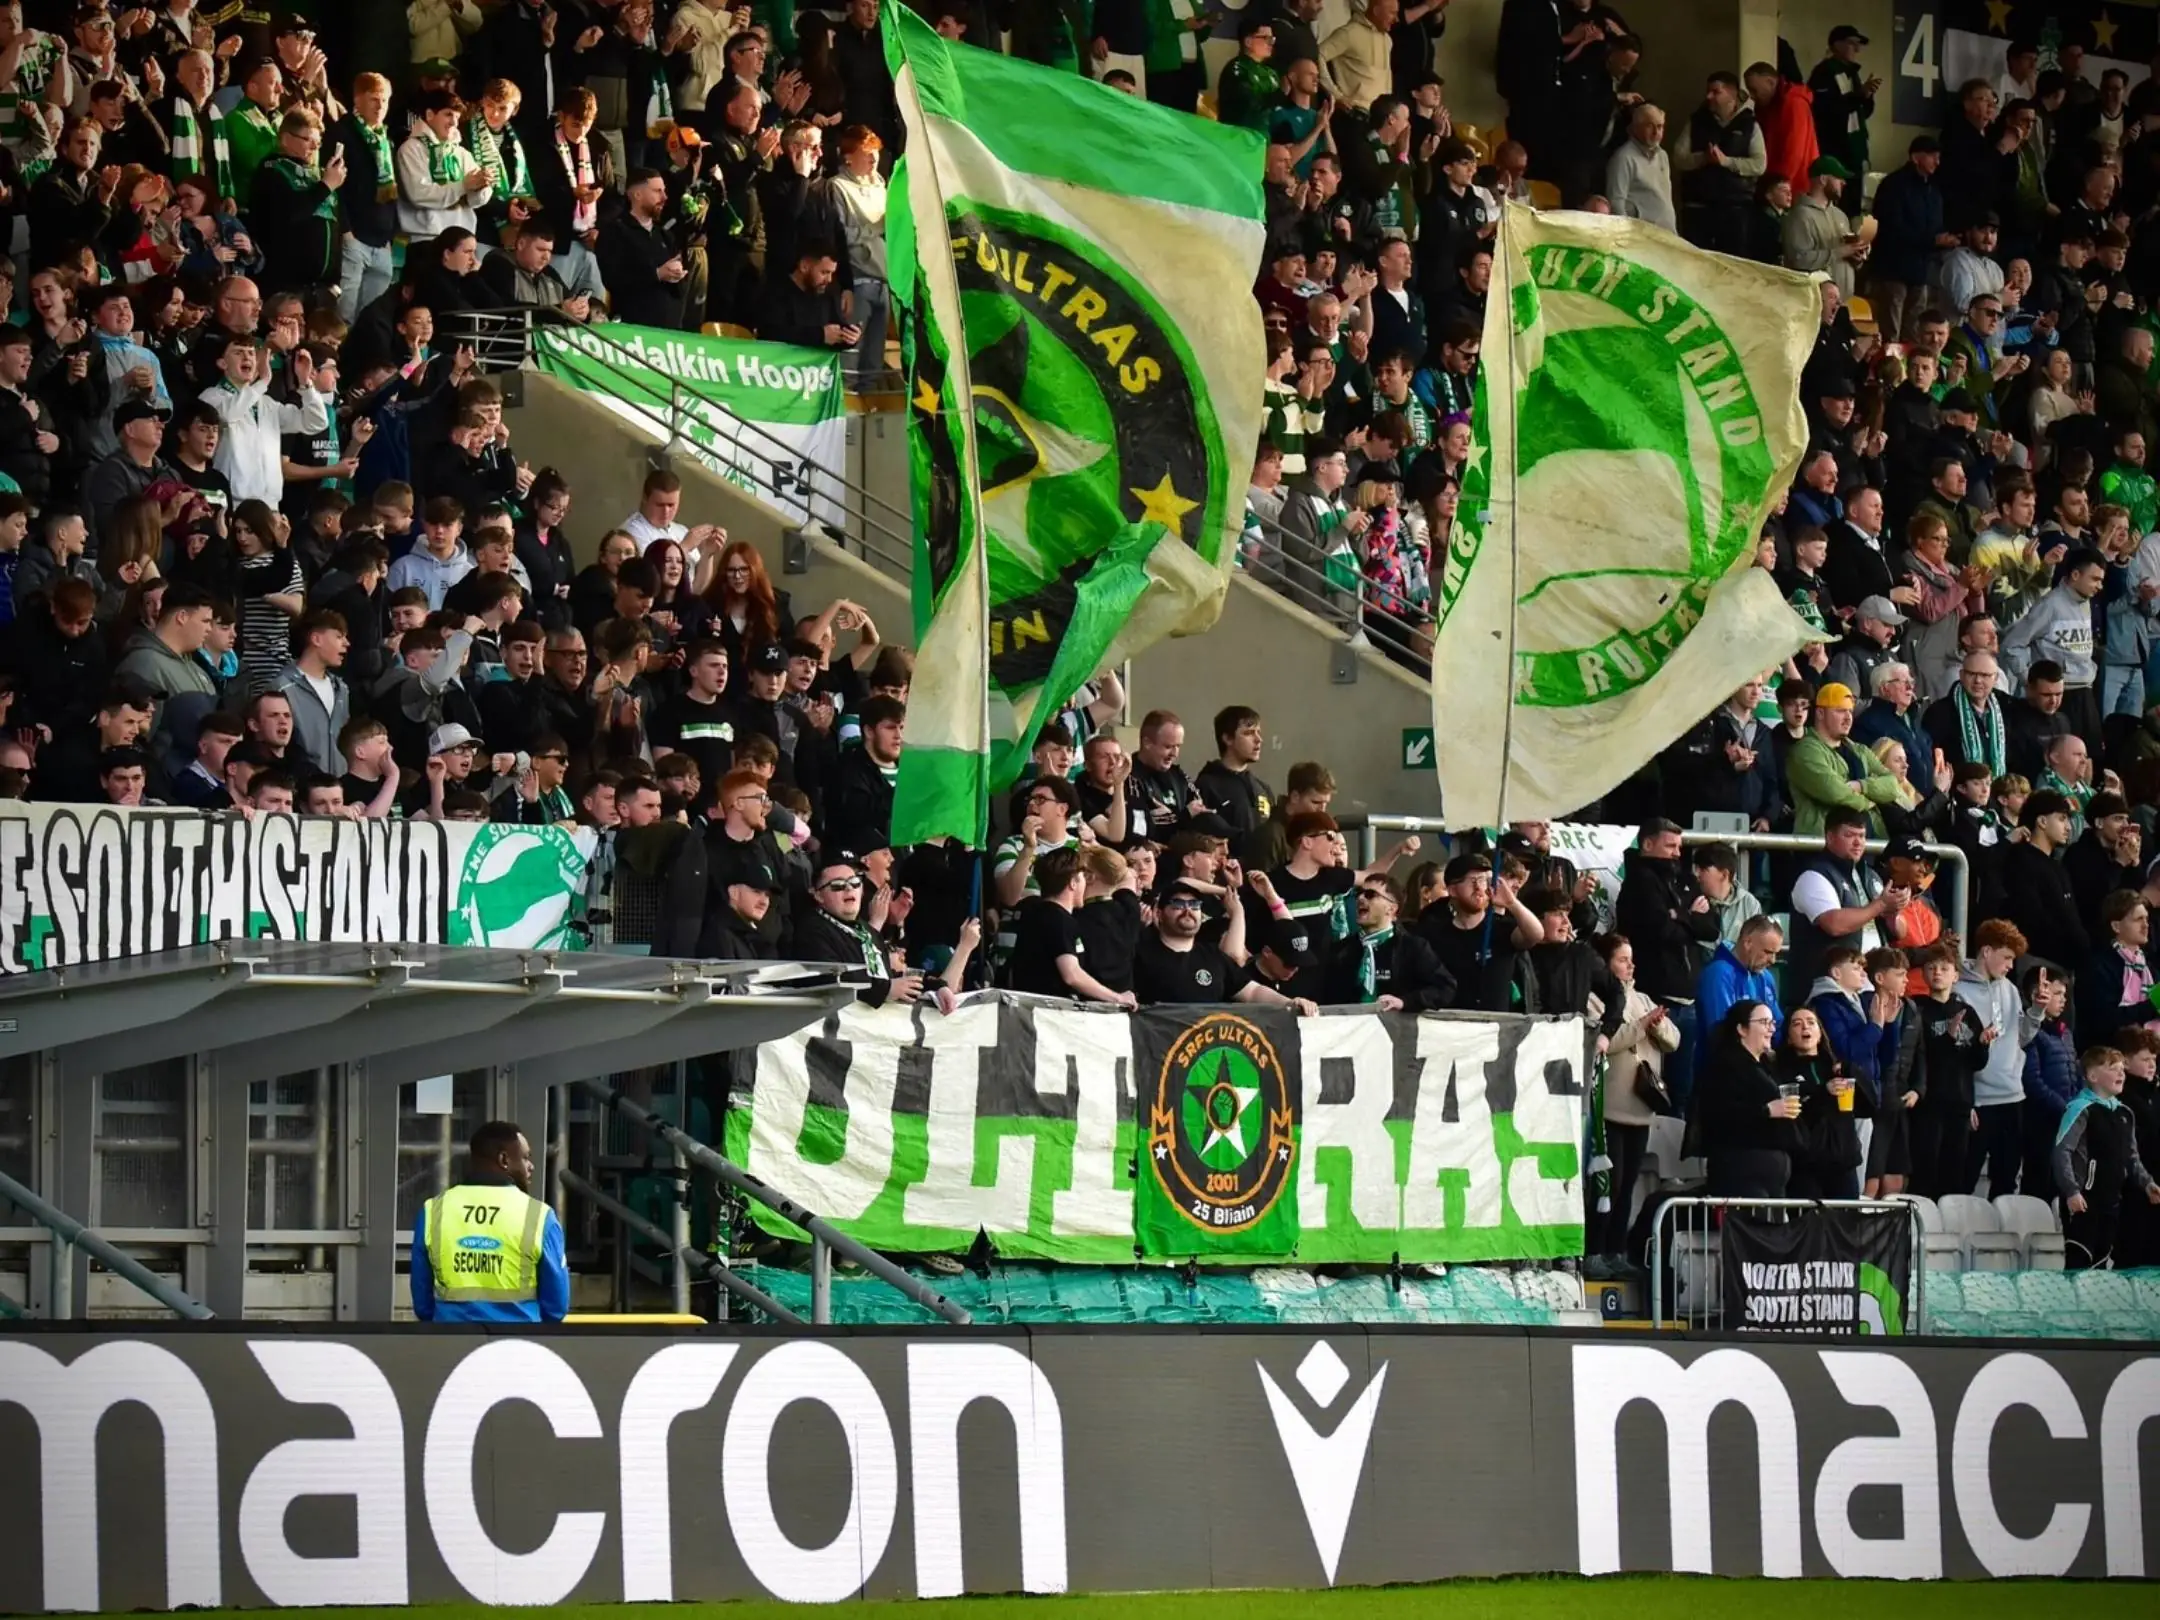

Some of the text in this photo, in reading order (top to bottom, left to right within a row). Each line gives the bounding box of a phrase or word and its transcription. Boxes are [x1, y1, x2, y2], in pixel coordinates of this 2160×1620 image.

[1901, 14, 1939, 98] 4
[543, 324, 834, 400] Clondalkin Hoops
[1523, 248, 1760, 447] UTH STAND
[462, 841, 488, 883] THE
[46, 811, 248, 968] SOUTH
[261, 812, 441, 945] STAND
[1178, 1025, 1268, 1069] SRFC ULTRAS
[1206, 1173, 1239, 1192] 2001
[463, 1205, 500, 1225] 707
[1192, 1200, 1255, 1225] 25 Bliain
[453, 1252, 504, 1274] SECURITY
[1742, 1260, 1854, 1290] NORTH STAND
[1606, 1294, 1617, 1311] G
[1745, 1294, 1854, 1322] SOUTH STAND
[0, 1338, 1068, 1613] macron
